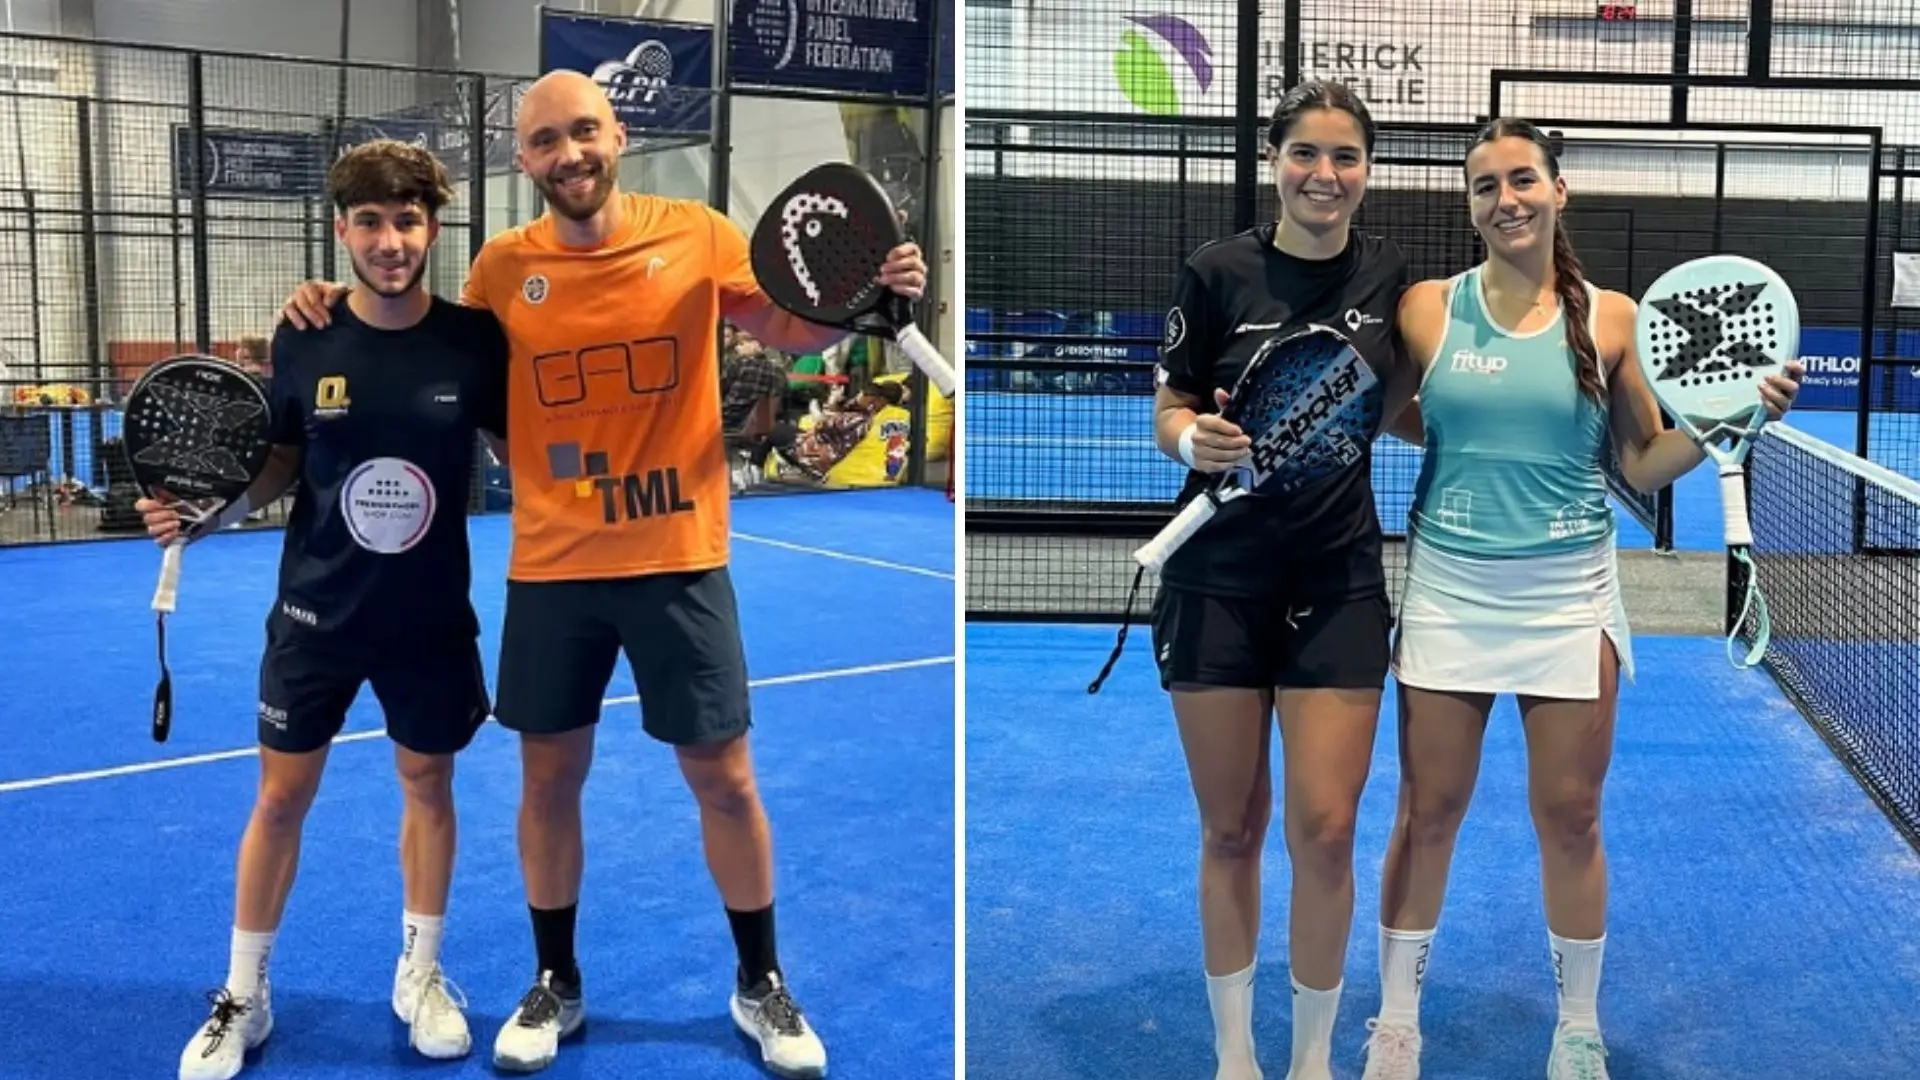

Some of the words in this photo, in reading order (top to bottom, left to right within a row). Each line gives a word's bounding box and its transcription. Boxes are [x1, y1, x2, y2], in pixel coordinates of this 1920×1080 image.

[805, 14, 852, 43] PADEL
[805, 42, 893, 73] FEDERATION
[1265, 40, 1424, 71] IERICK
[1802, 375, 1829, 387] Ready
[1832, 376, 1842, 386] to
[594, 467, 695, 524] TML
